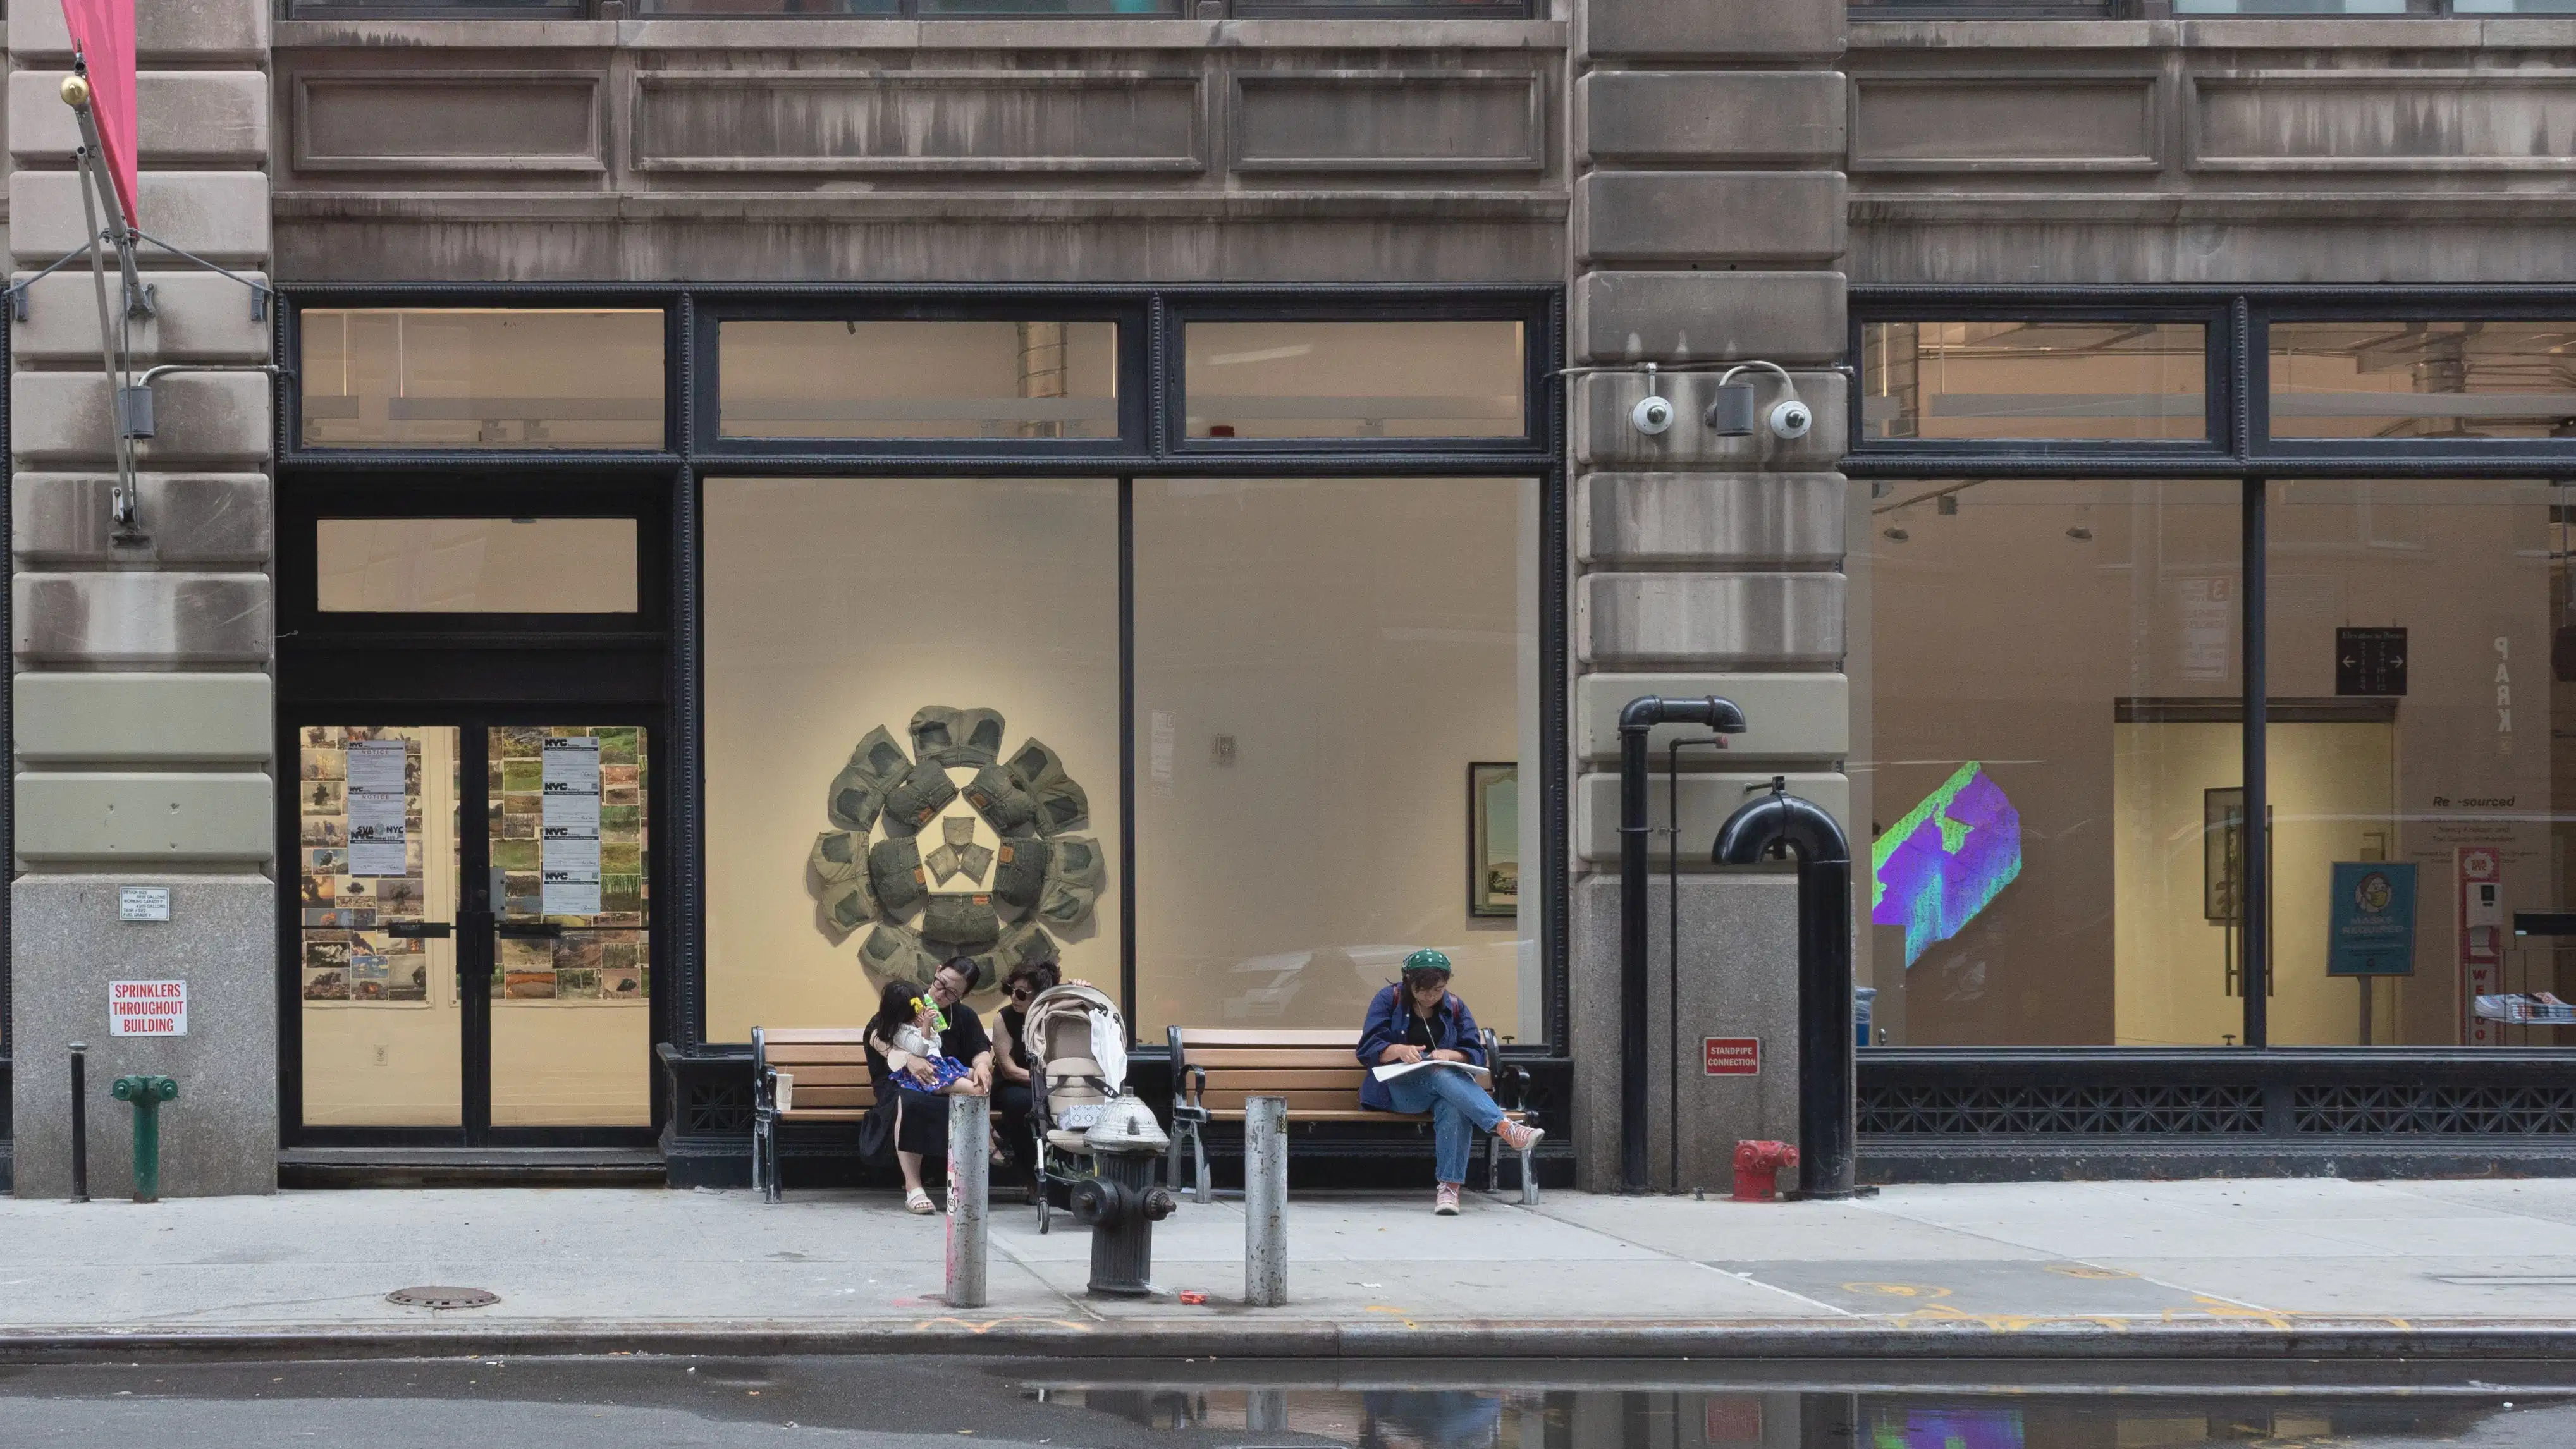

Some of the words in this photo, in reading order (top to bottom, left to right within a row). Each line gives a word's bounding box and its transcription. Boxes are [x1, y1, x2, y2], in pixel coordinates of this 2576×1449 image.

[544, 738, 568, 747] NYC
[544, 783, 568, 791] NYC
[545, 828, 568, 836] NYC
[115, 984, 181, 998] SPRINKLERS
[113, 1001, 184, 1015] THROUGHOUT
[123, 1018, 174, 1032] BUILDING
[1707, 1058, 1756, 1066] CONNECTION
